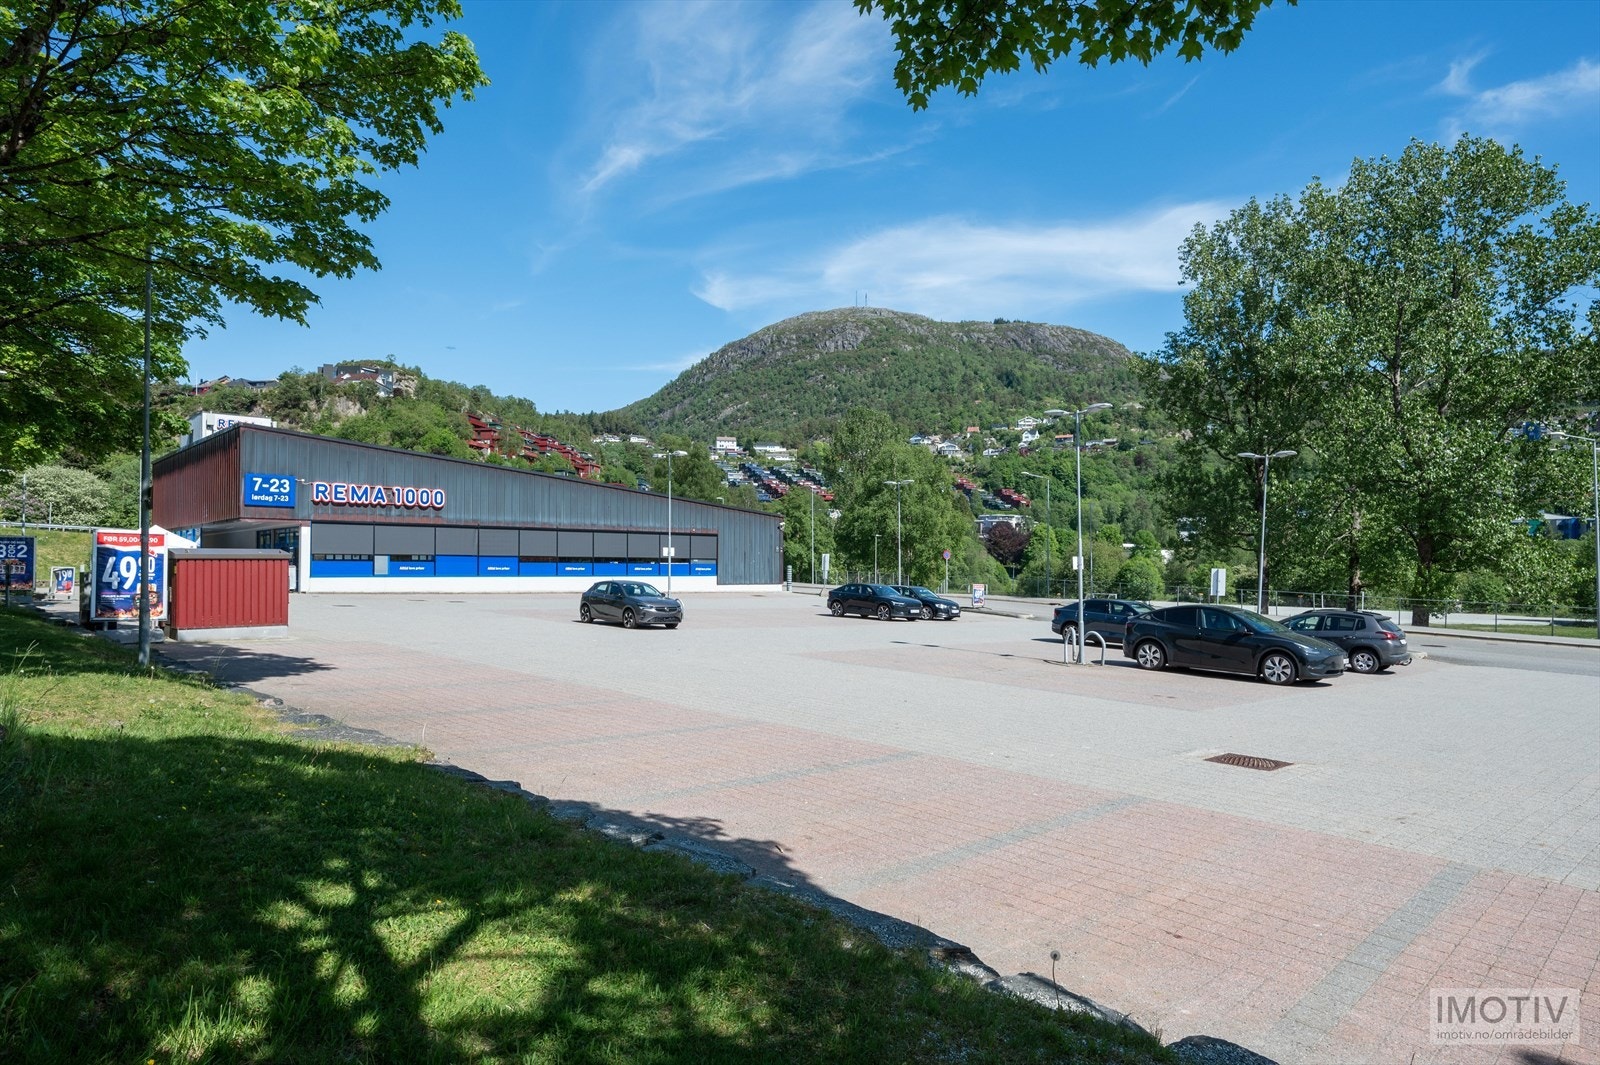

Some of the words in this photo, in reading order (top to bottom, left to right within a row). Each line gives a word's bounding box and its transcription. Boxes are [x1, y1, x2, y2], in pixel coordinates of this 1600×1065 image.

[252, 477, 290, 493] 7-23
[251, 494, 273, 502] lørdag
[313, 482, 387, 505] REMA
[394, 487, 445, 507] 1000
[8, 544, 16, 558] FOR
[16, 544, 28, 558] 2
[102, 555, 138, 590] 49
